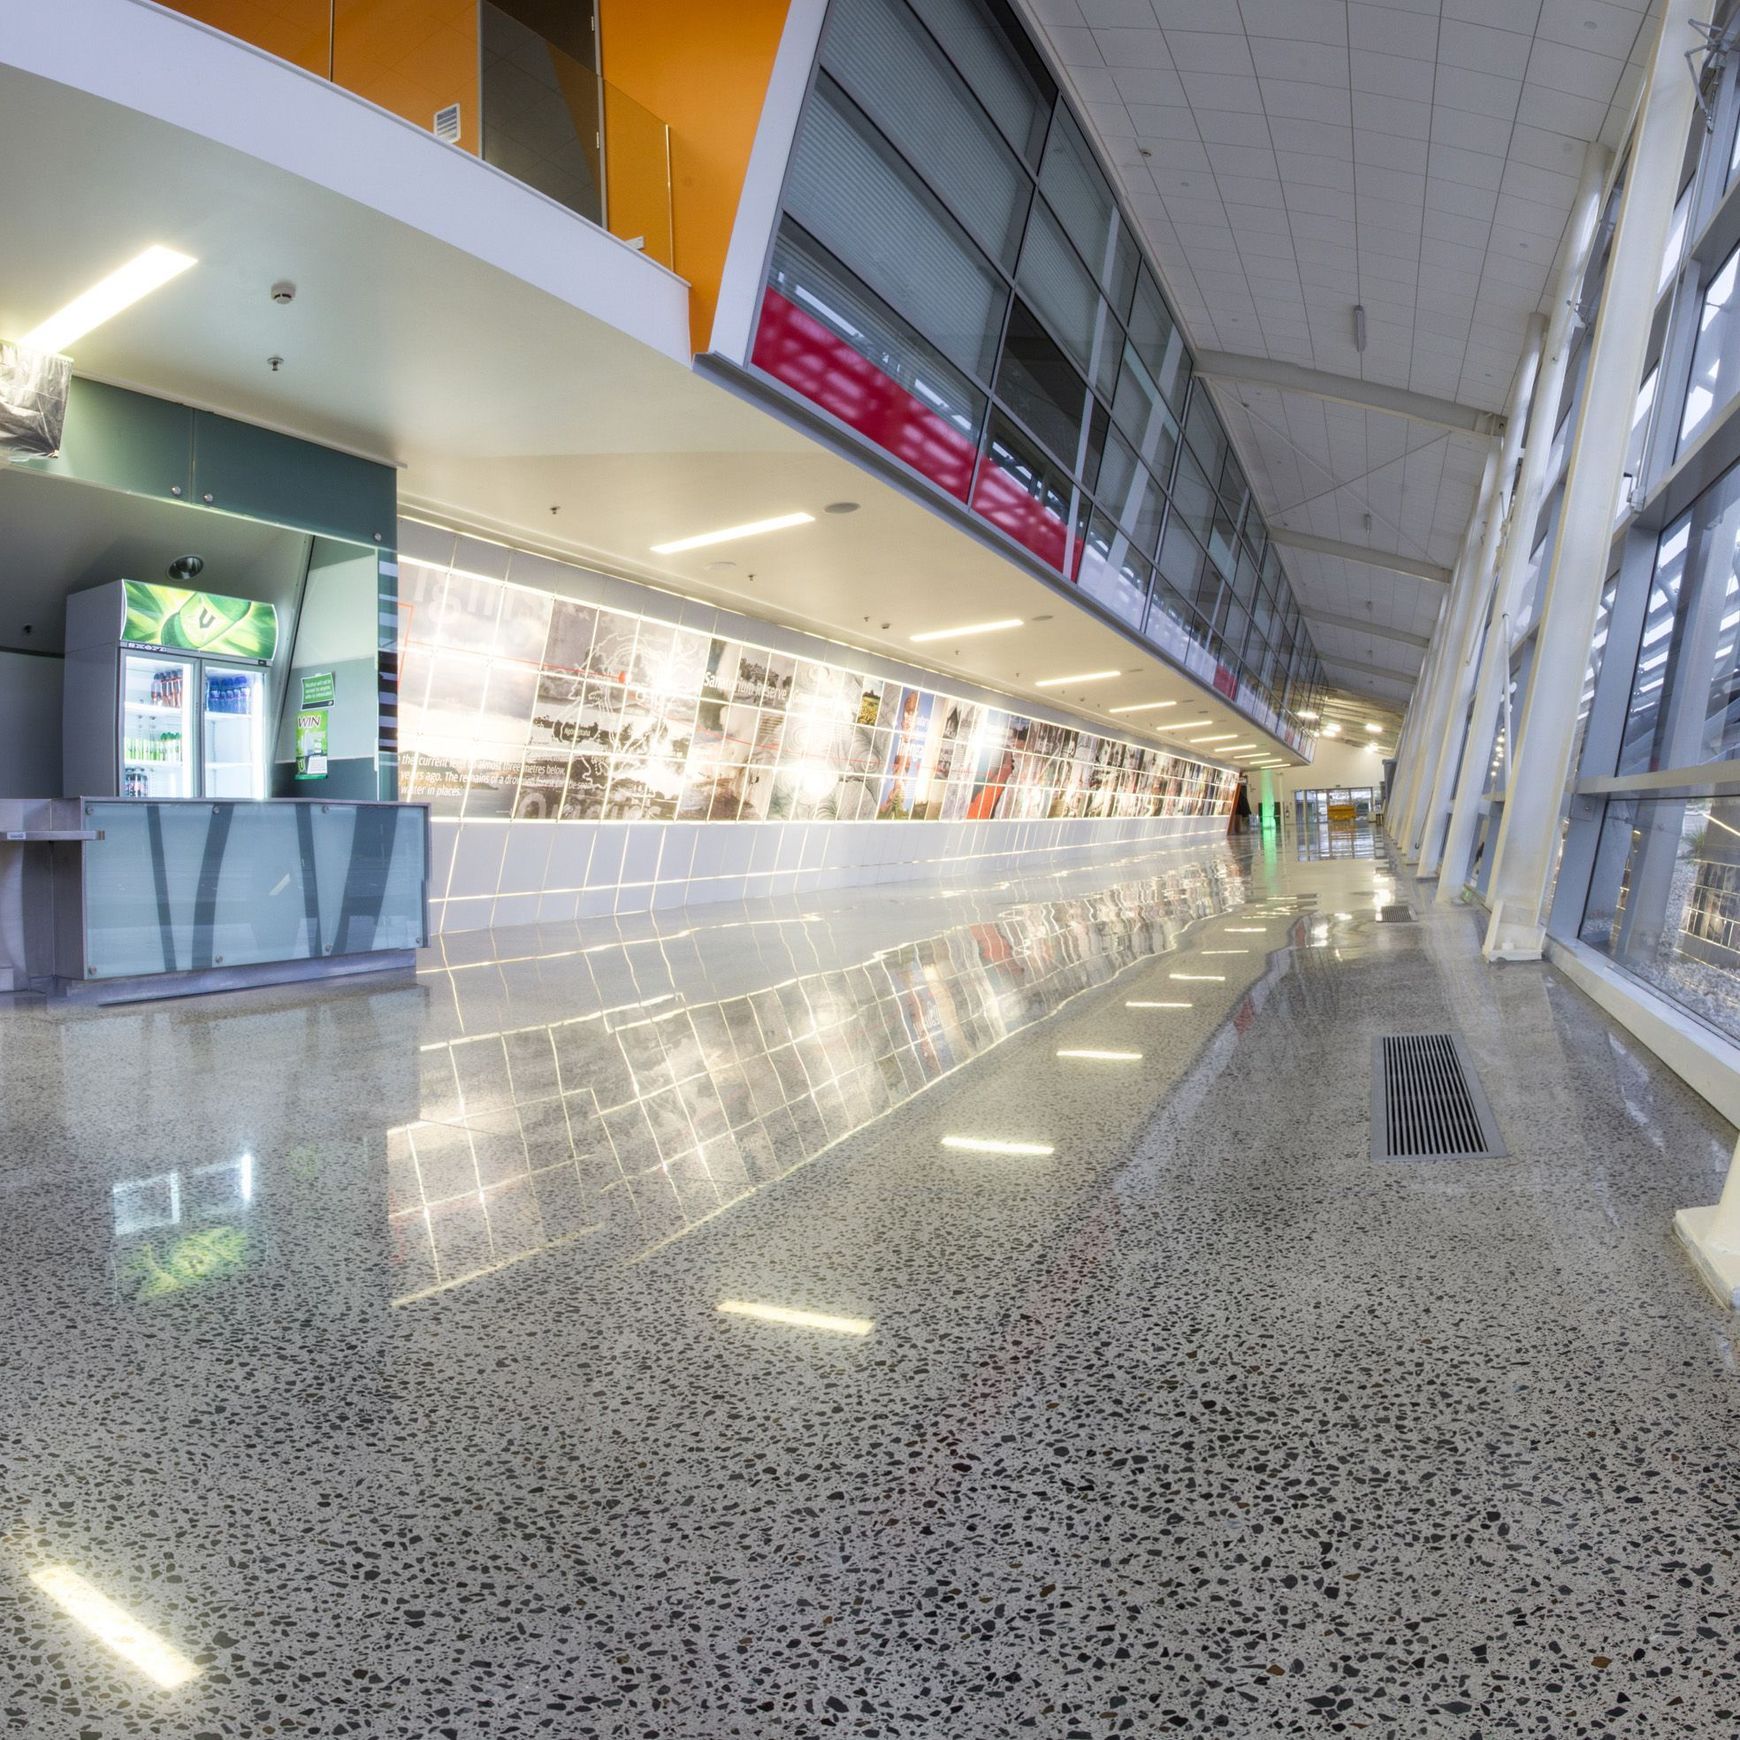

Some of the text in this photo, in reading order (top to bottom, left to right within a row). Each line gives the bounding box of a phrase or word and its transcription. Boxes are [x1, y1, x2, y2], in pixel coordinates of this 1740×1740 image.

[298, 716, 320, 728] WIN
[418, 756, 449, 768] current
[503, 760, 521, 772] three
[524, 764, 545, 774] metres
[425, 772, 442, 783] ago.
[446, 772, 459, 782] The
